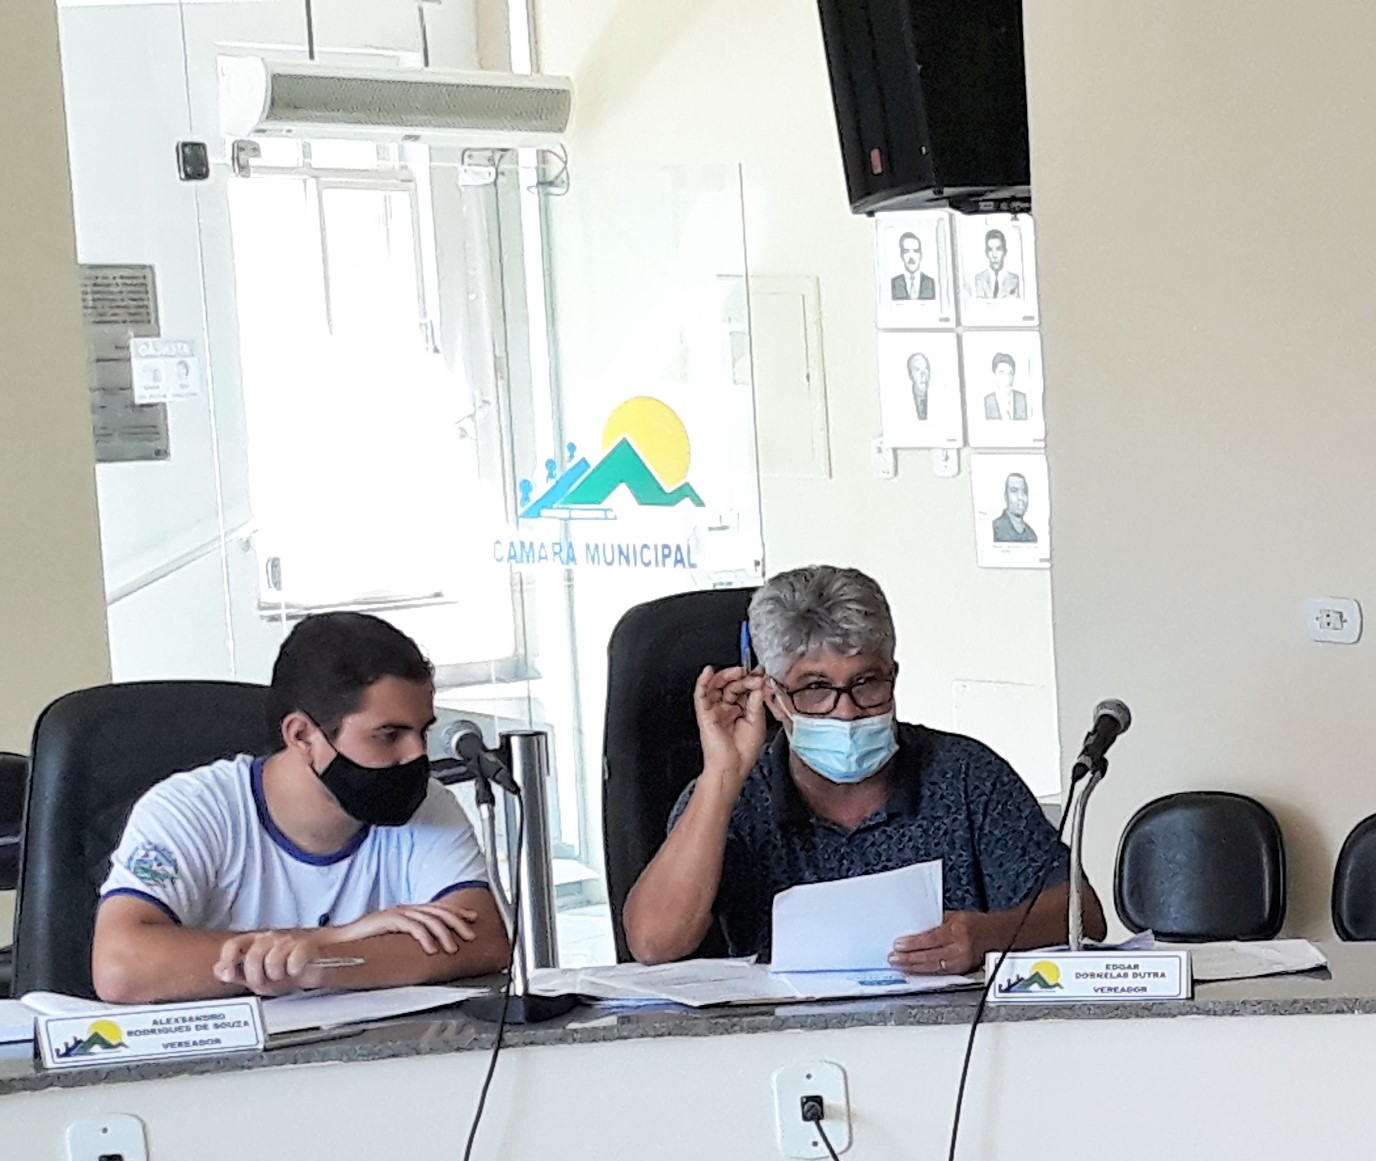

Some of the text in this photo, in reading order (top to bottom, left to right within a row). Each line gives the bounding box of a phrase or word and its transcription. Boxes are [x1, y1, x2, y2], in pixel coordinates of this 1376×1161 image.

[585, 542, 698, 569] MUNICIPAL
[1105, 963, 1140, 971] EDGAR
[1132, 971, 1167, 979] DUTRA
[1092, 985, 1148, 994] VEREADOR
[126, 1019, 250, 1037] RODRIGUES DE SOUZA
[161, 1037, 222, 1050] VEREADOR
